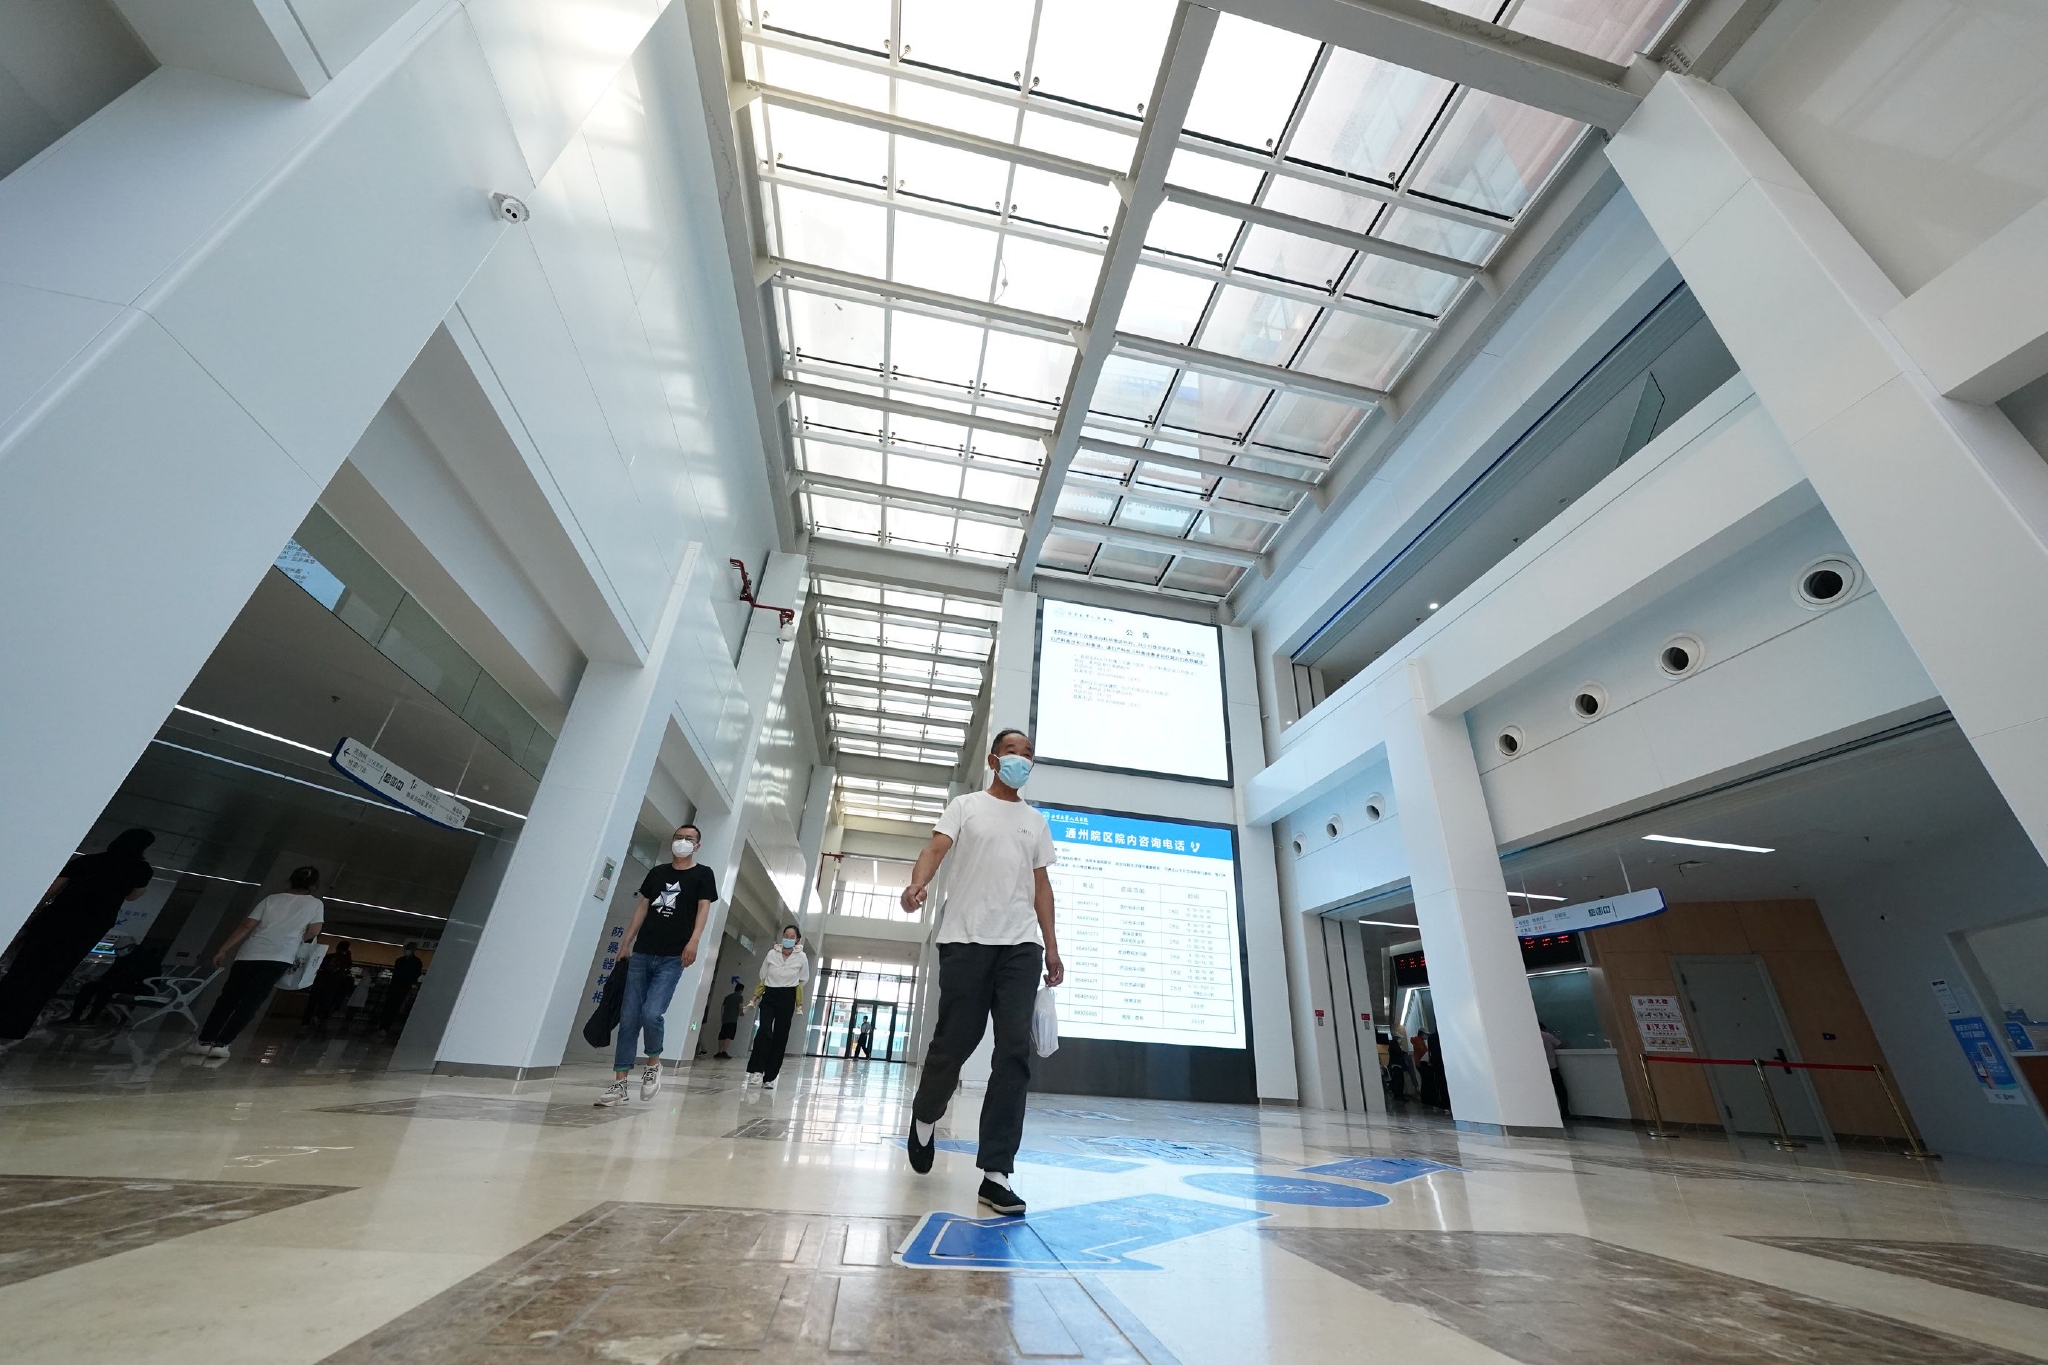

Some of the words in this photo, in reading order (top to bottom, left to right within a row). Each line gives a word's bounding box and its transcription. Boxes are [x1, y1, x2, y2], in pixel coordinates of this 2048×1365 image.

[1125, 629, 1150, 639] 公告
[1065, 827, 1185, 852] 通州院区院内咨询电话
